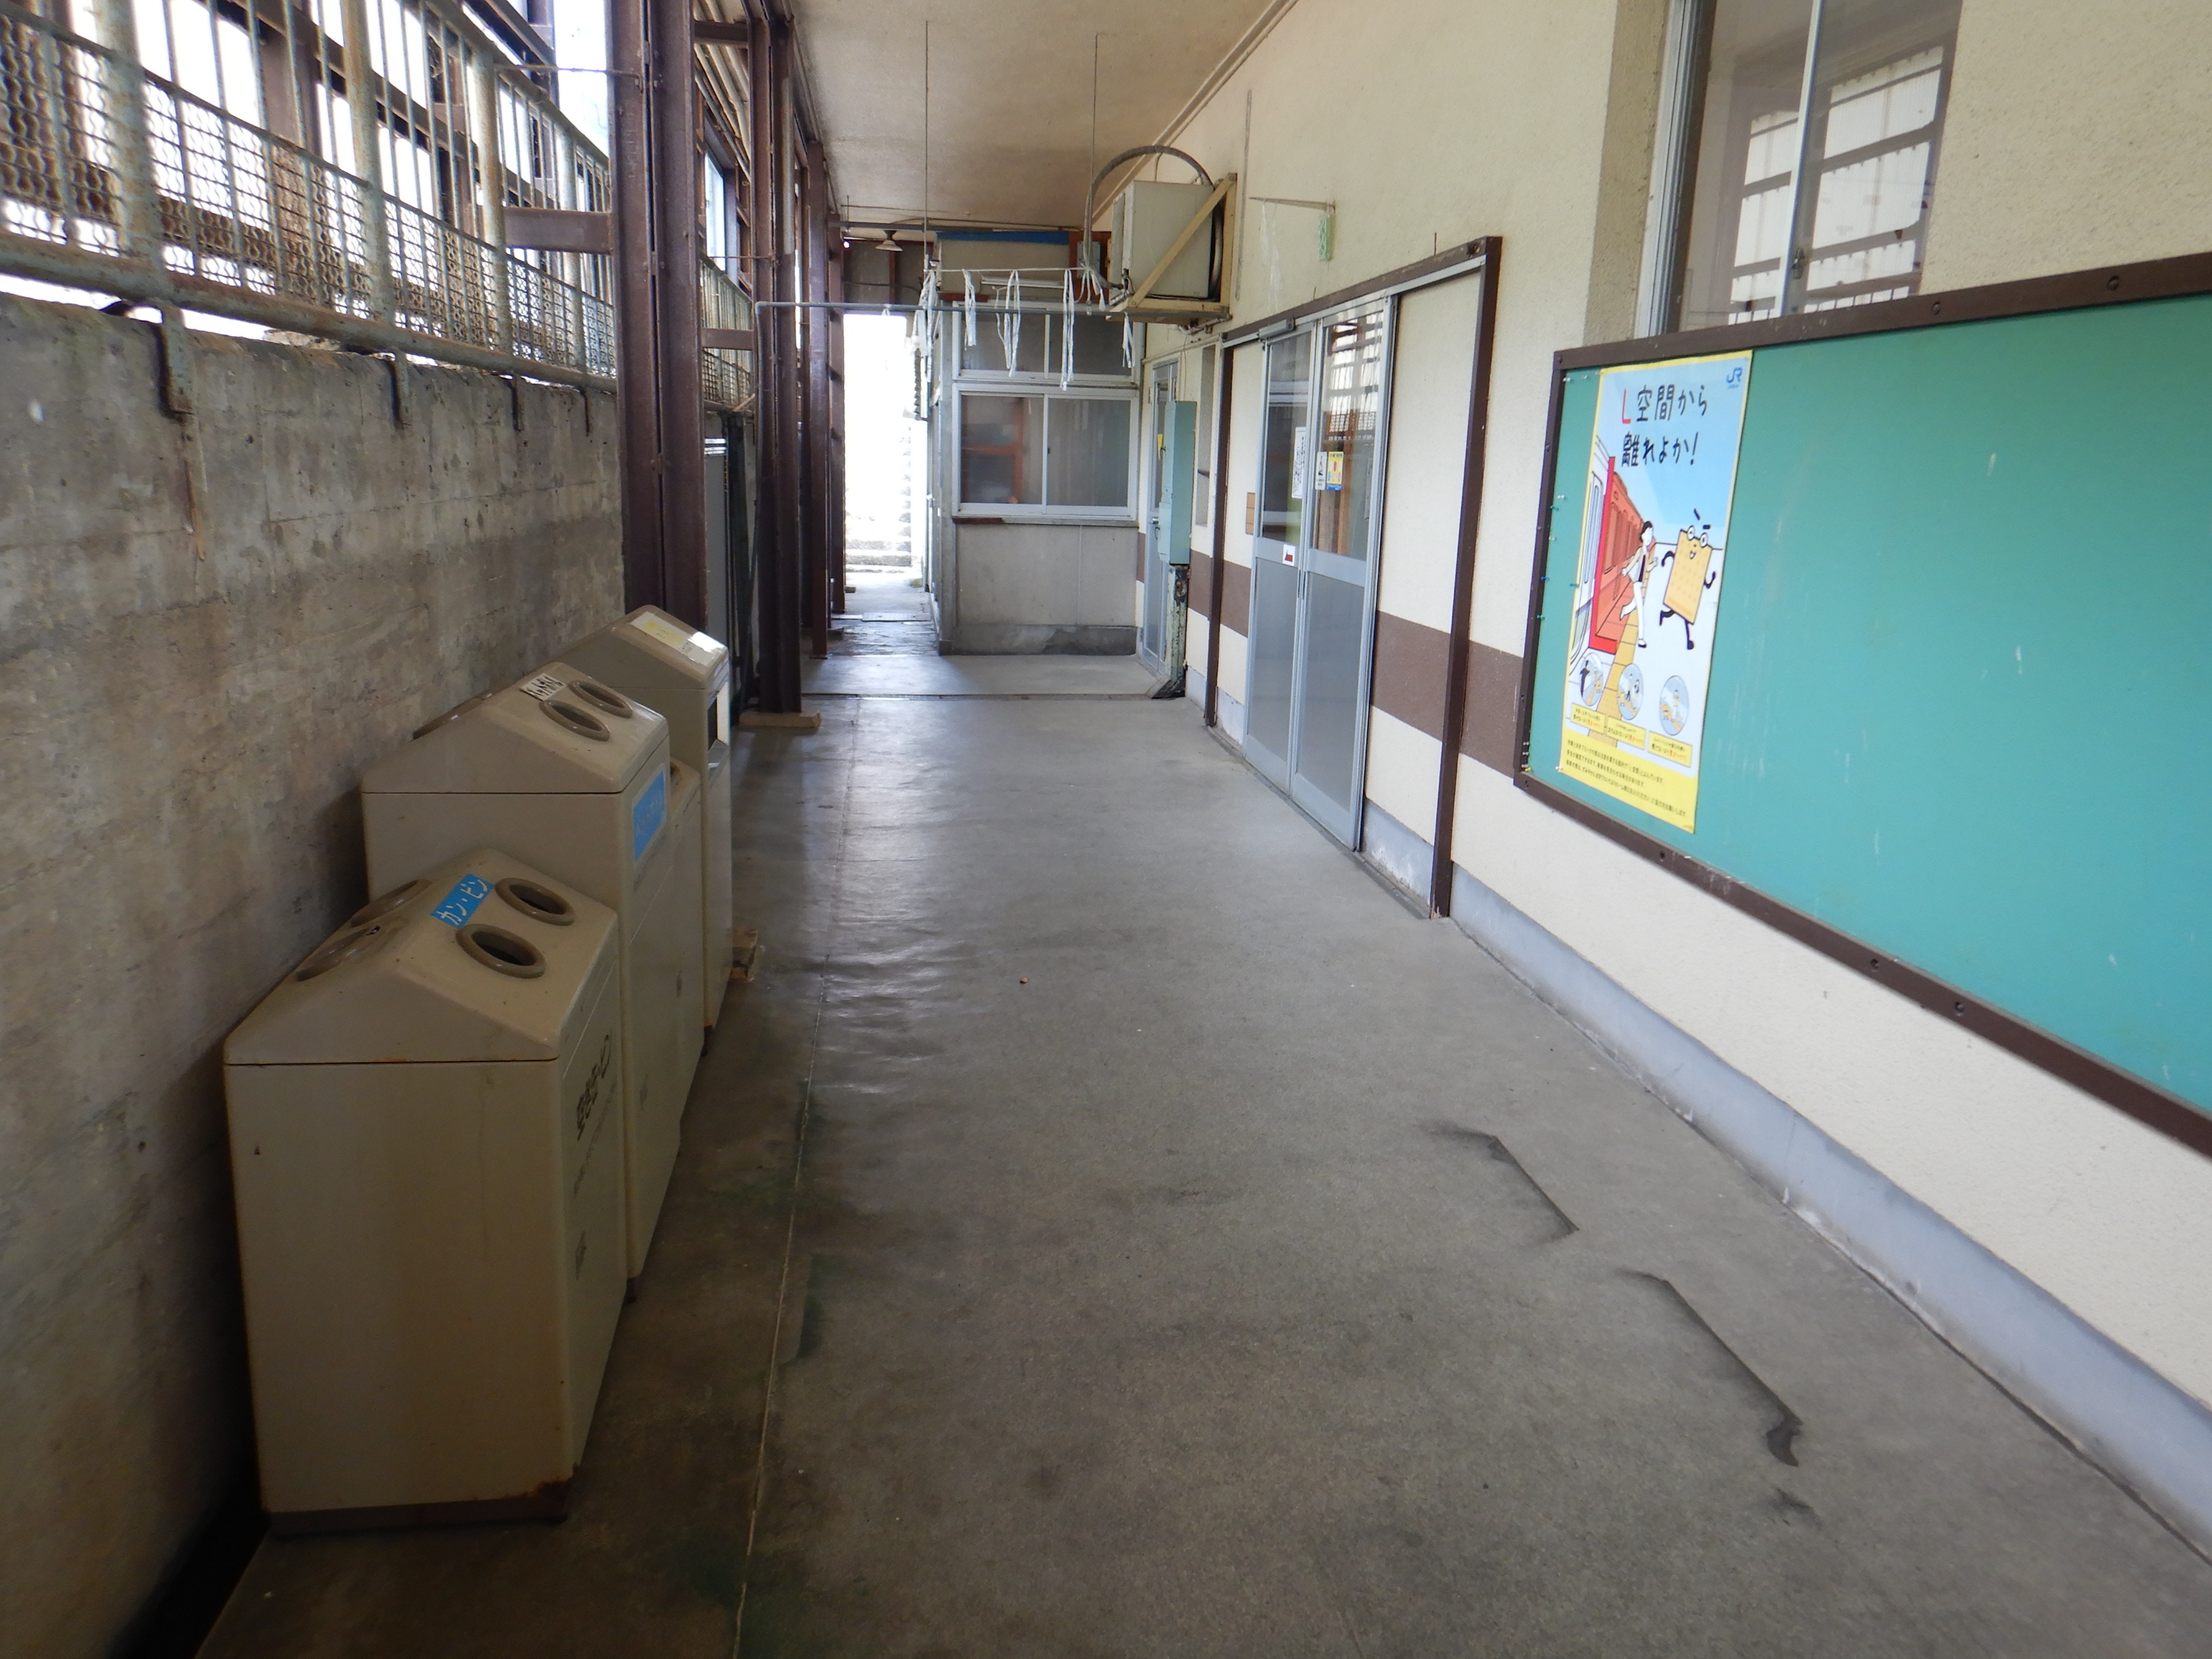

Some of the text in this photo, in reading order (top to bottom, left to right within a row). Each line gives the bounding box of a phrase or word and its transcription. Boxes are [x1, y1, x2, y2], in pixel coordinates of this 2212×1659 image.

[1727, 367, 1742, 383] JR
[1622, 384, 1707, 424] L空間から
[436, 879, 488, 926] カン・ビン
